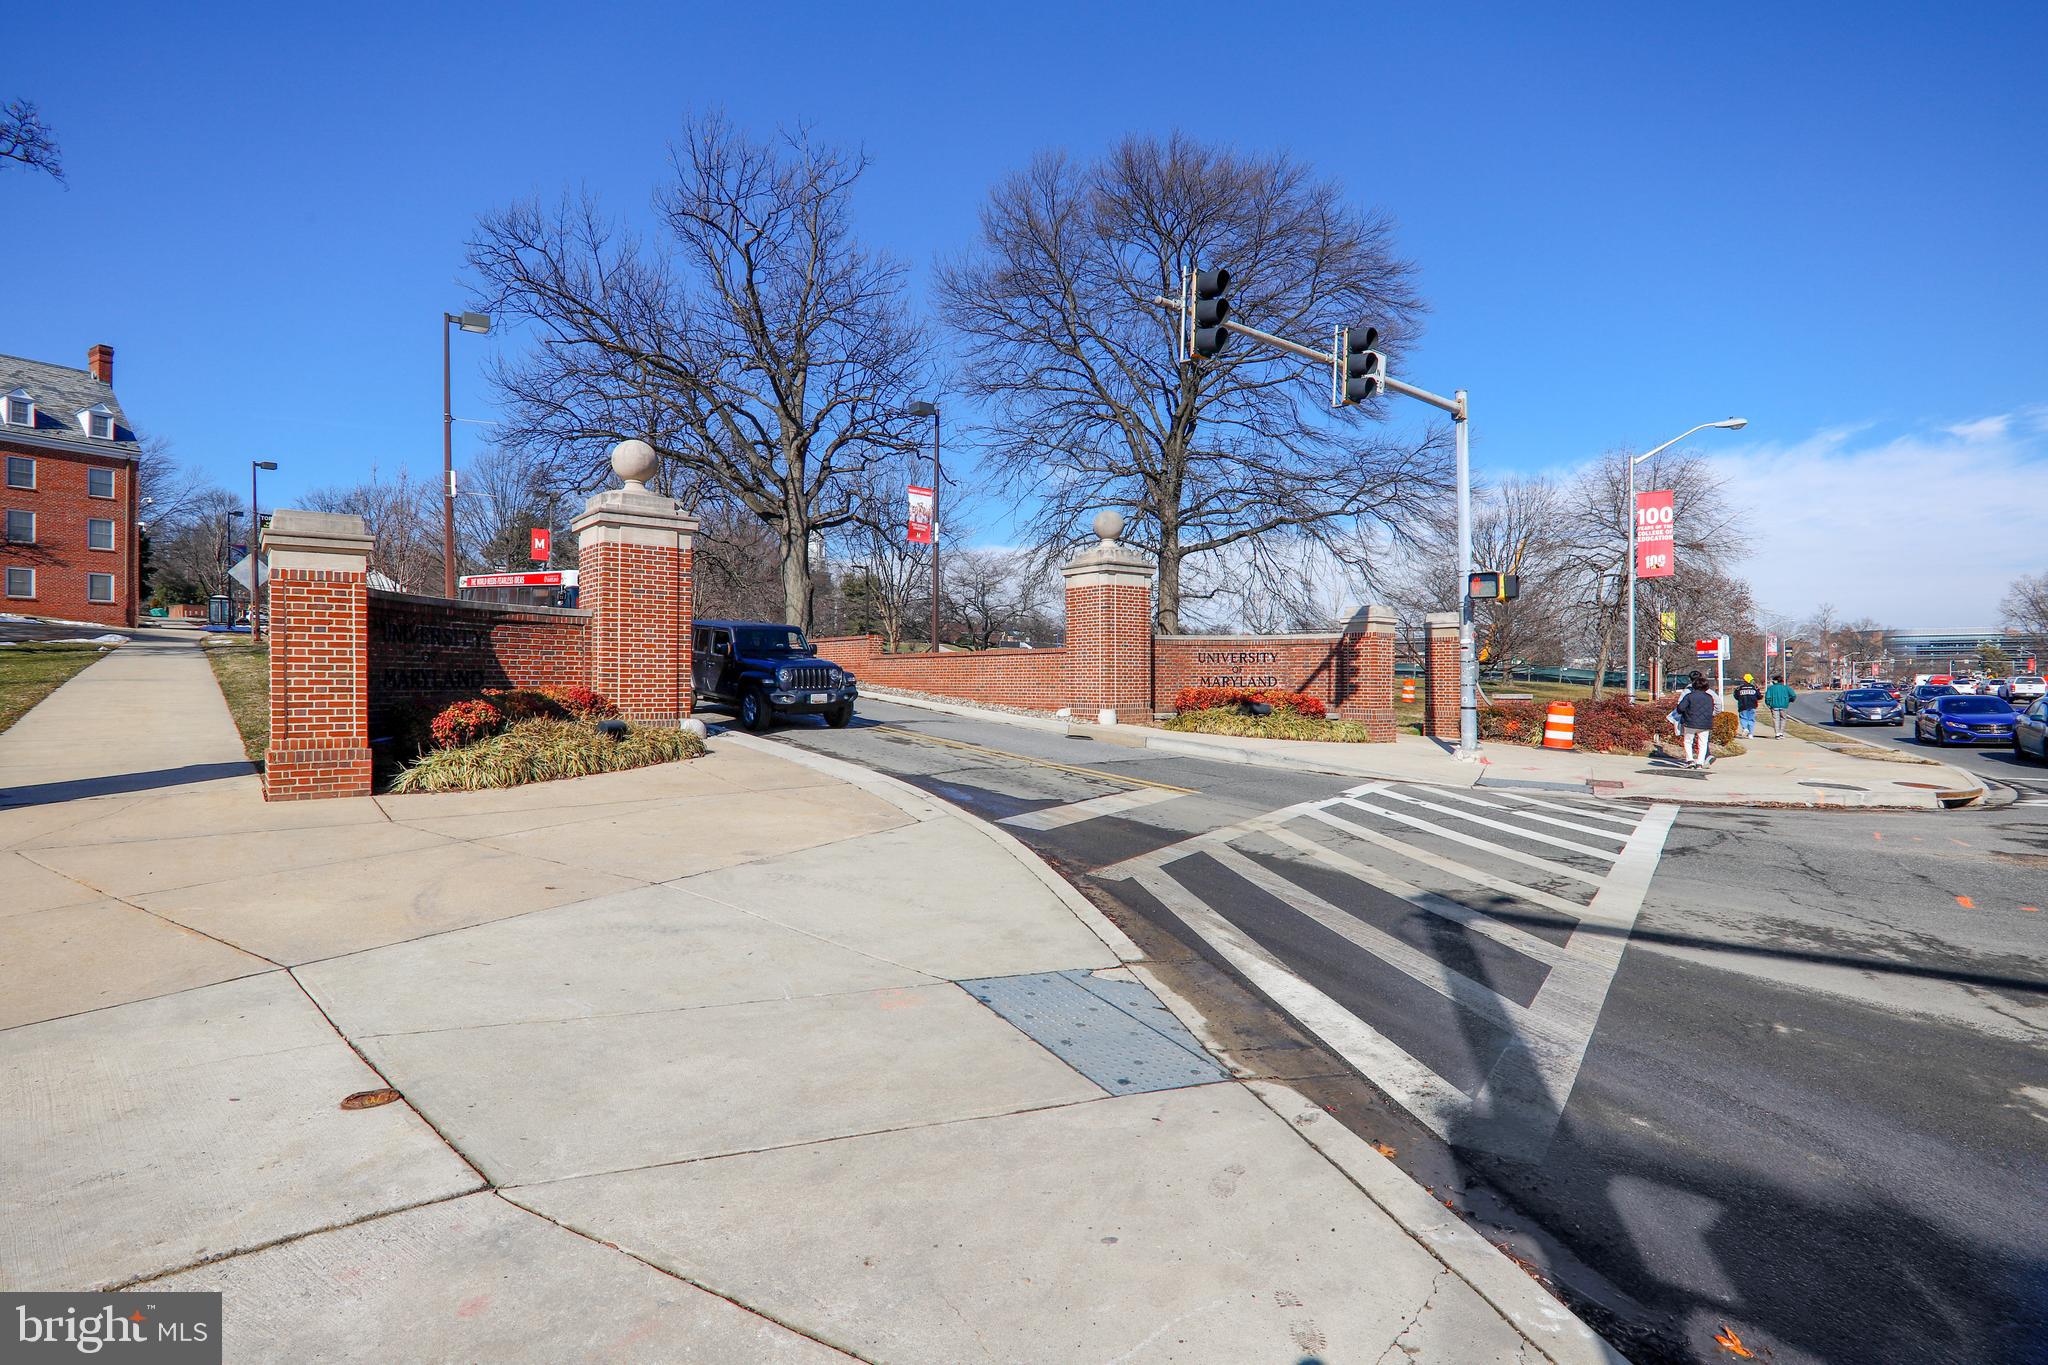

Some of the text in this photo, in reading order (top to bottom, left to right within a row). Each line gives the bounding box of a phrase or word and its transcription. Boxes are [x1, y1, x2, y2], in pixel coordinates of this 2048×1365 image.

[1637, 506, 1673, 525] 100
[534, 538, 545, 549] M
[384, 622, 484, 647] UNIVERSITY
[1198, 652, 1279, 664] UNIVERSITY
[1232, 666, 1242, 674] OF
[383, 669, 485, 690] MARYLAND
[1200, 676, 1278, 688] MARYLAND
